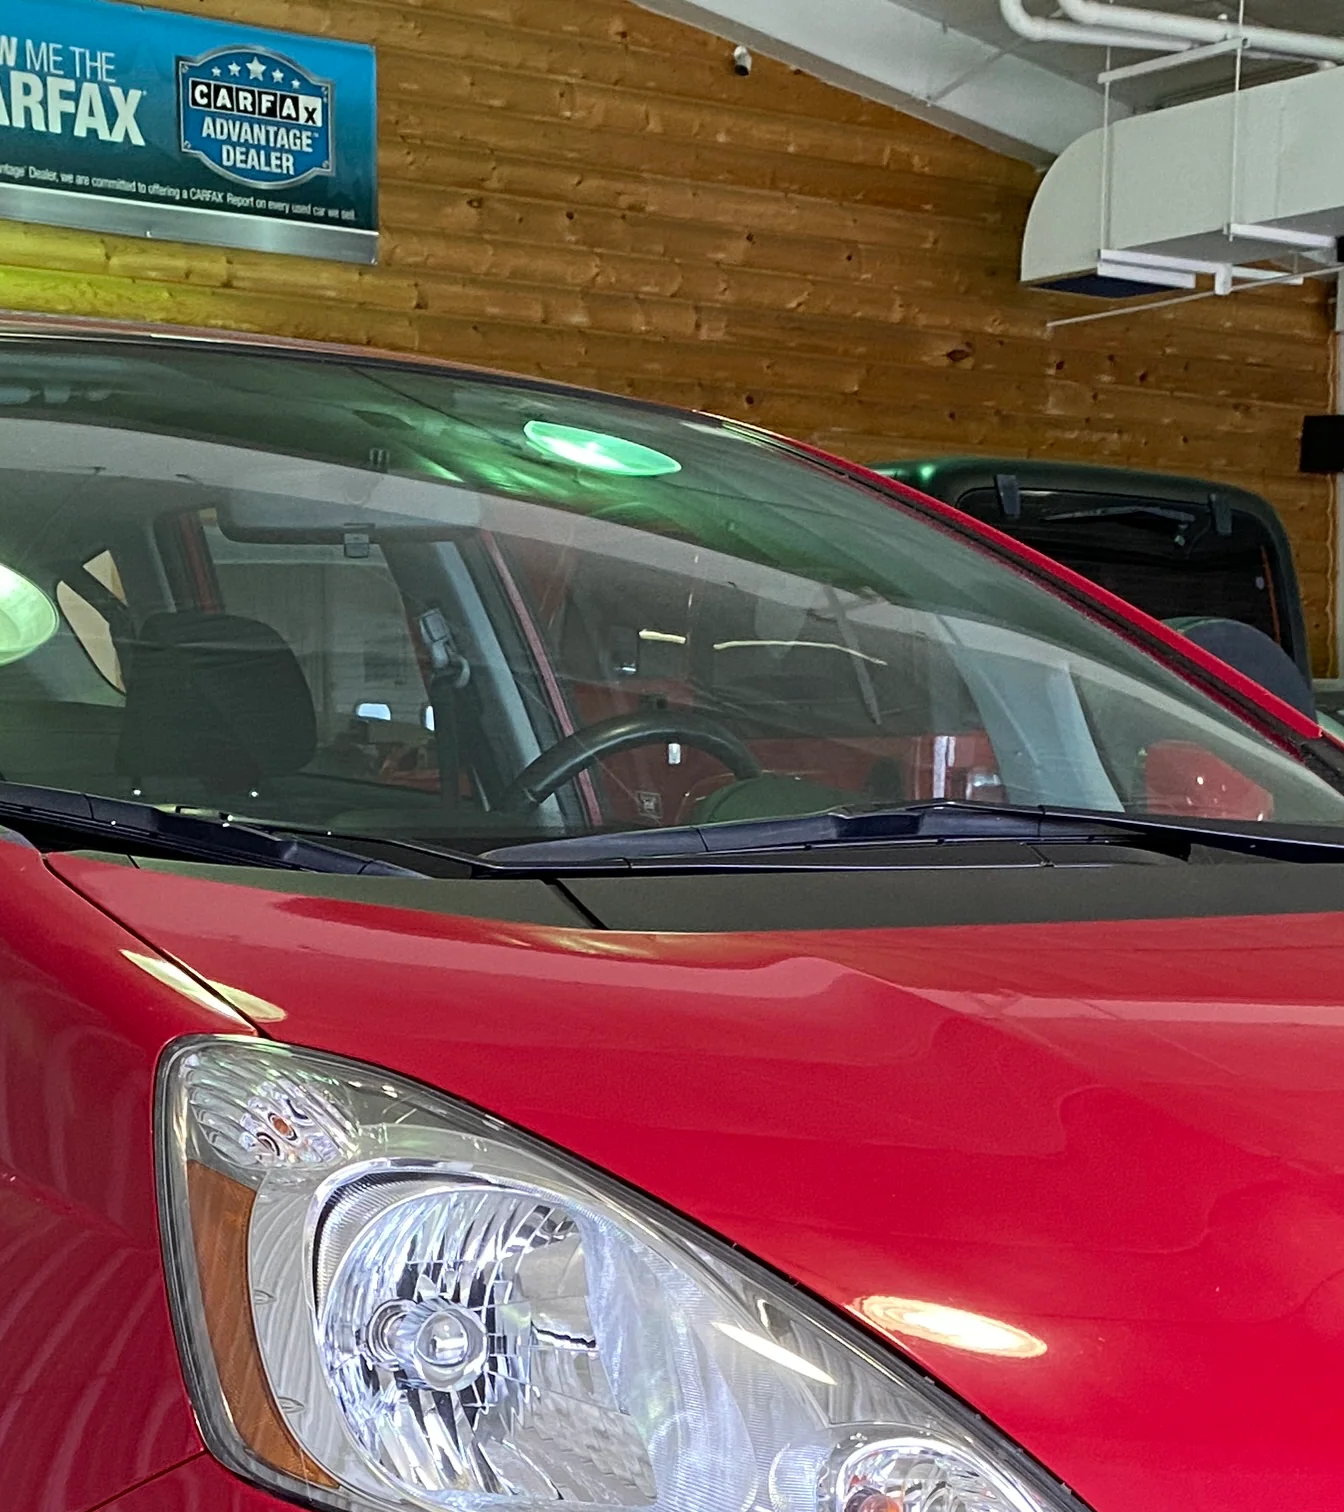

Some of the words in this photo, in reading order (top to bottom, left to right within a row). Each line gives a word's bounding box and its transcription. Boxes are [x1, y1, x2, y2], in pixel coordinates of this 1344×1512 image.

[25, 39, 64, 75] ME
[69, 46, 116, 83] THE
[193, 83, 317, 125] CARFAX
[201, 116, 314, 153] ADVANTAGE
[221, 145, 295, 175] DEALER
[59, 173, 74, 184] we
[75, 175, 90, 186] are
[91, 177, 136, 192] committed
[137, 182, 147, 194] to
[148, 183, 180, 200] offering
[182, 189, 188, 199] a
[189, 188, 225, 203] CARFAX
[226, 193, 254, 208] Report
[256, 199, 266, 209] on
[267, 201, 290, 214] every
[291, 203, 312, 215] used
[313, 206, 326, 217] car
